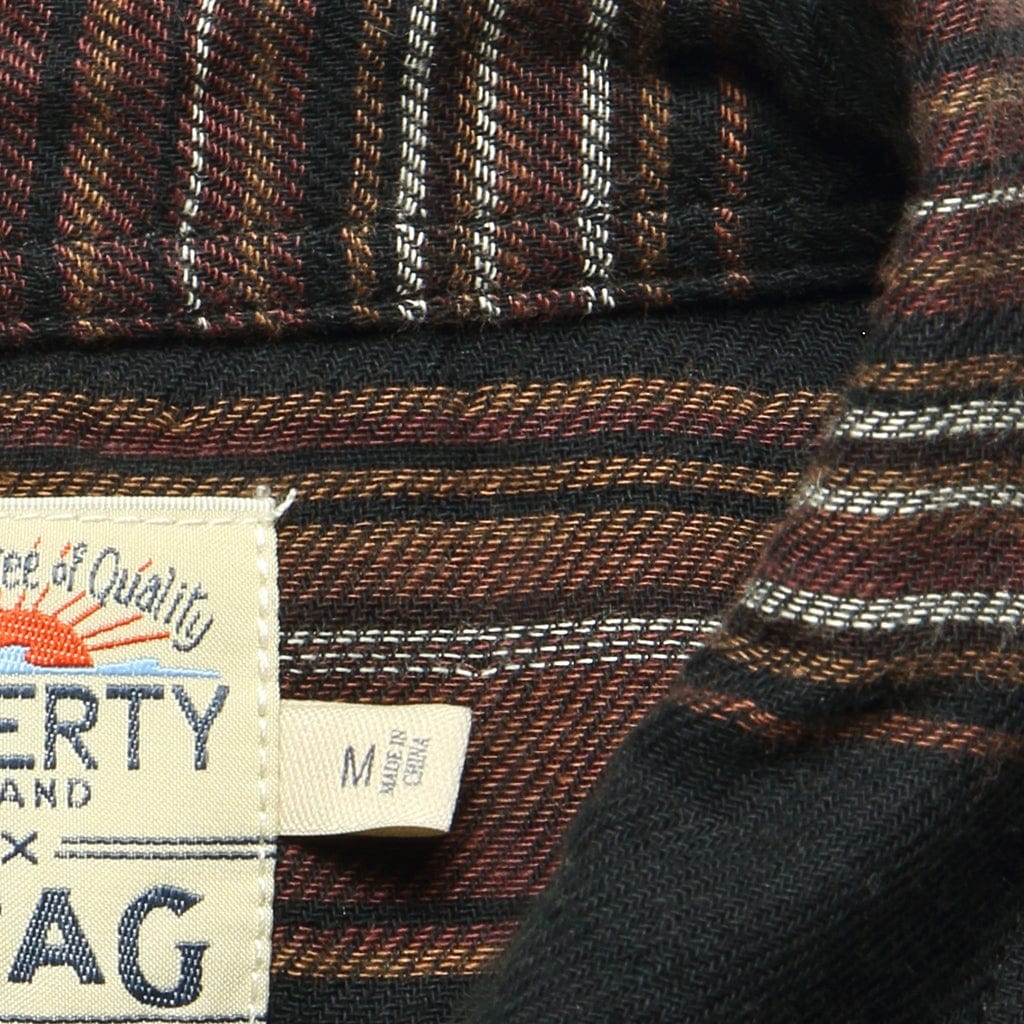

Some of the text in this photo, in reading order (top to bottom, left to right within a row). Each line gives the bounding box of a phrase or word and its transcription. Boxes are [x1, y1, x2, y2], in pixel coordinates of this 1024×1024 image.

[52, 541, 86, 594] of
[89, 546, 214, 652] Quality
[340, 743, 376, 789] M
[378, 728, 408, 796] MADE IN
[402, 737, 431, 787] CHINA
